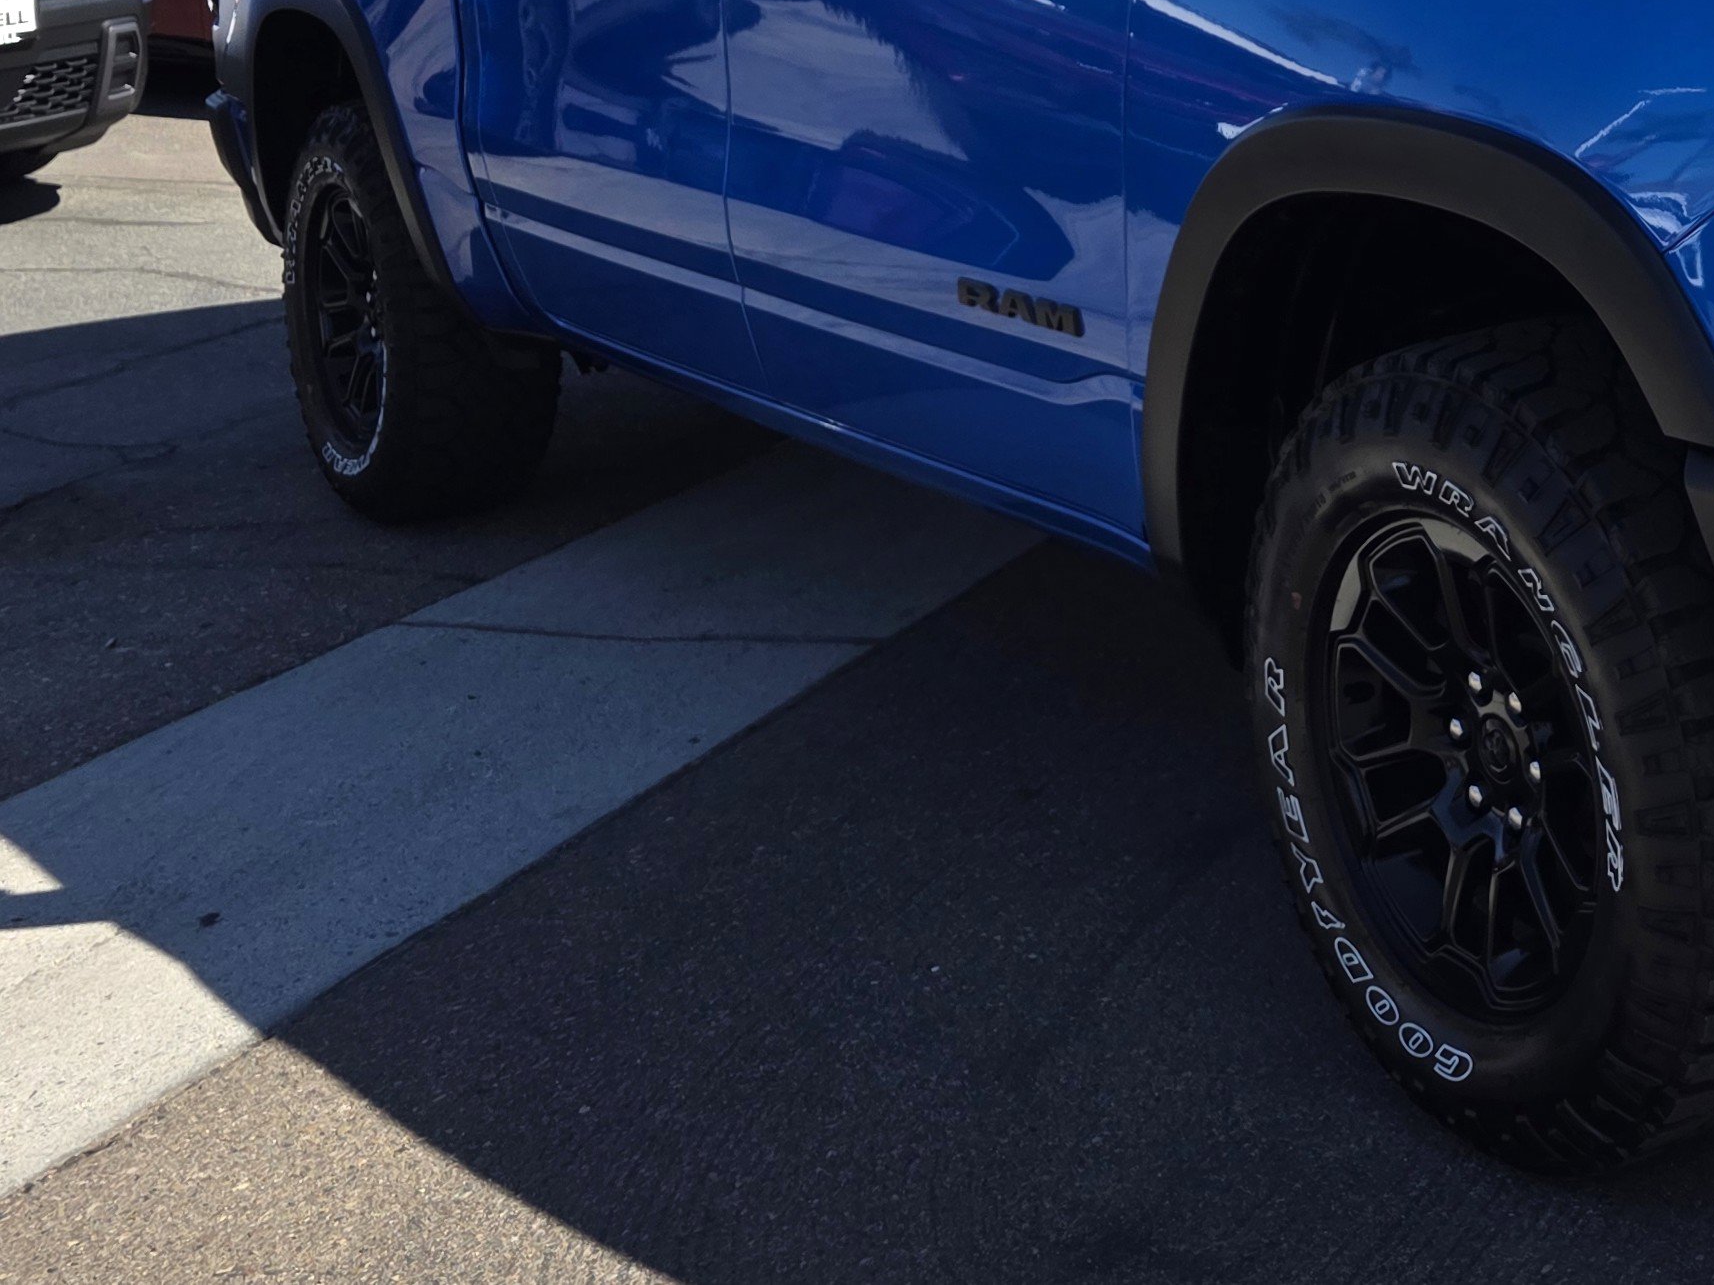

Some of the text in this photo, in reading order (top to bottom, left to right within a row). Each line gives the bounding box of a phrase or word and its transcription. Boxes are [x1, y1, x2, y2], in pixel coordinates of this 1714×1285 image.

[957, 276, 1085, 337] RAM
[1264, 656, 1474, 1083] GOODYEAR
[1390, 460, 1625, 893] WRANGLER
